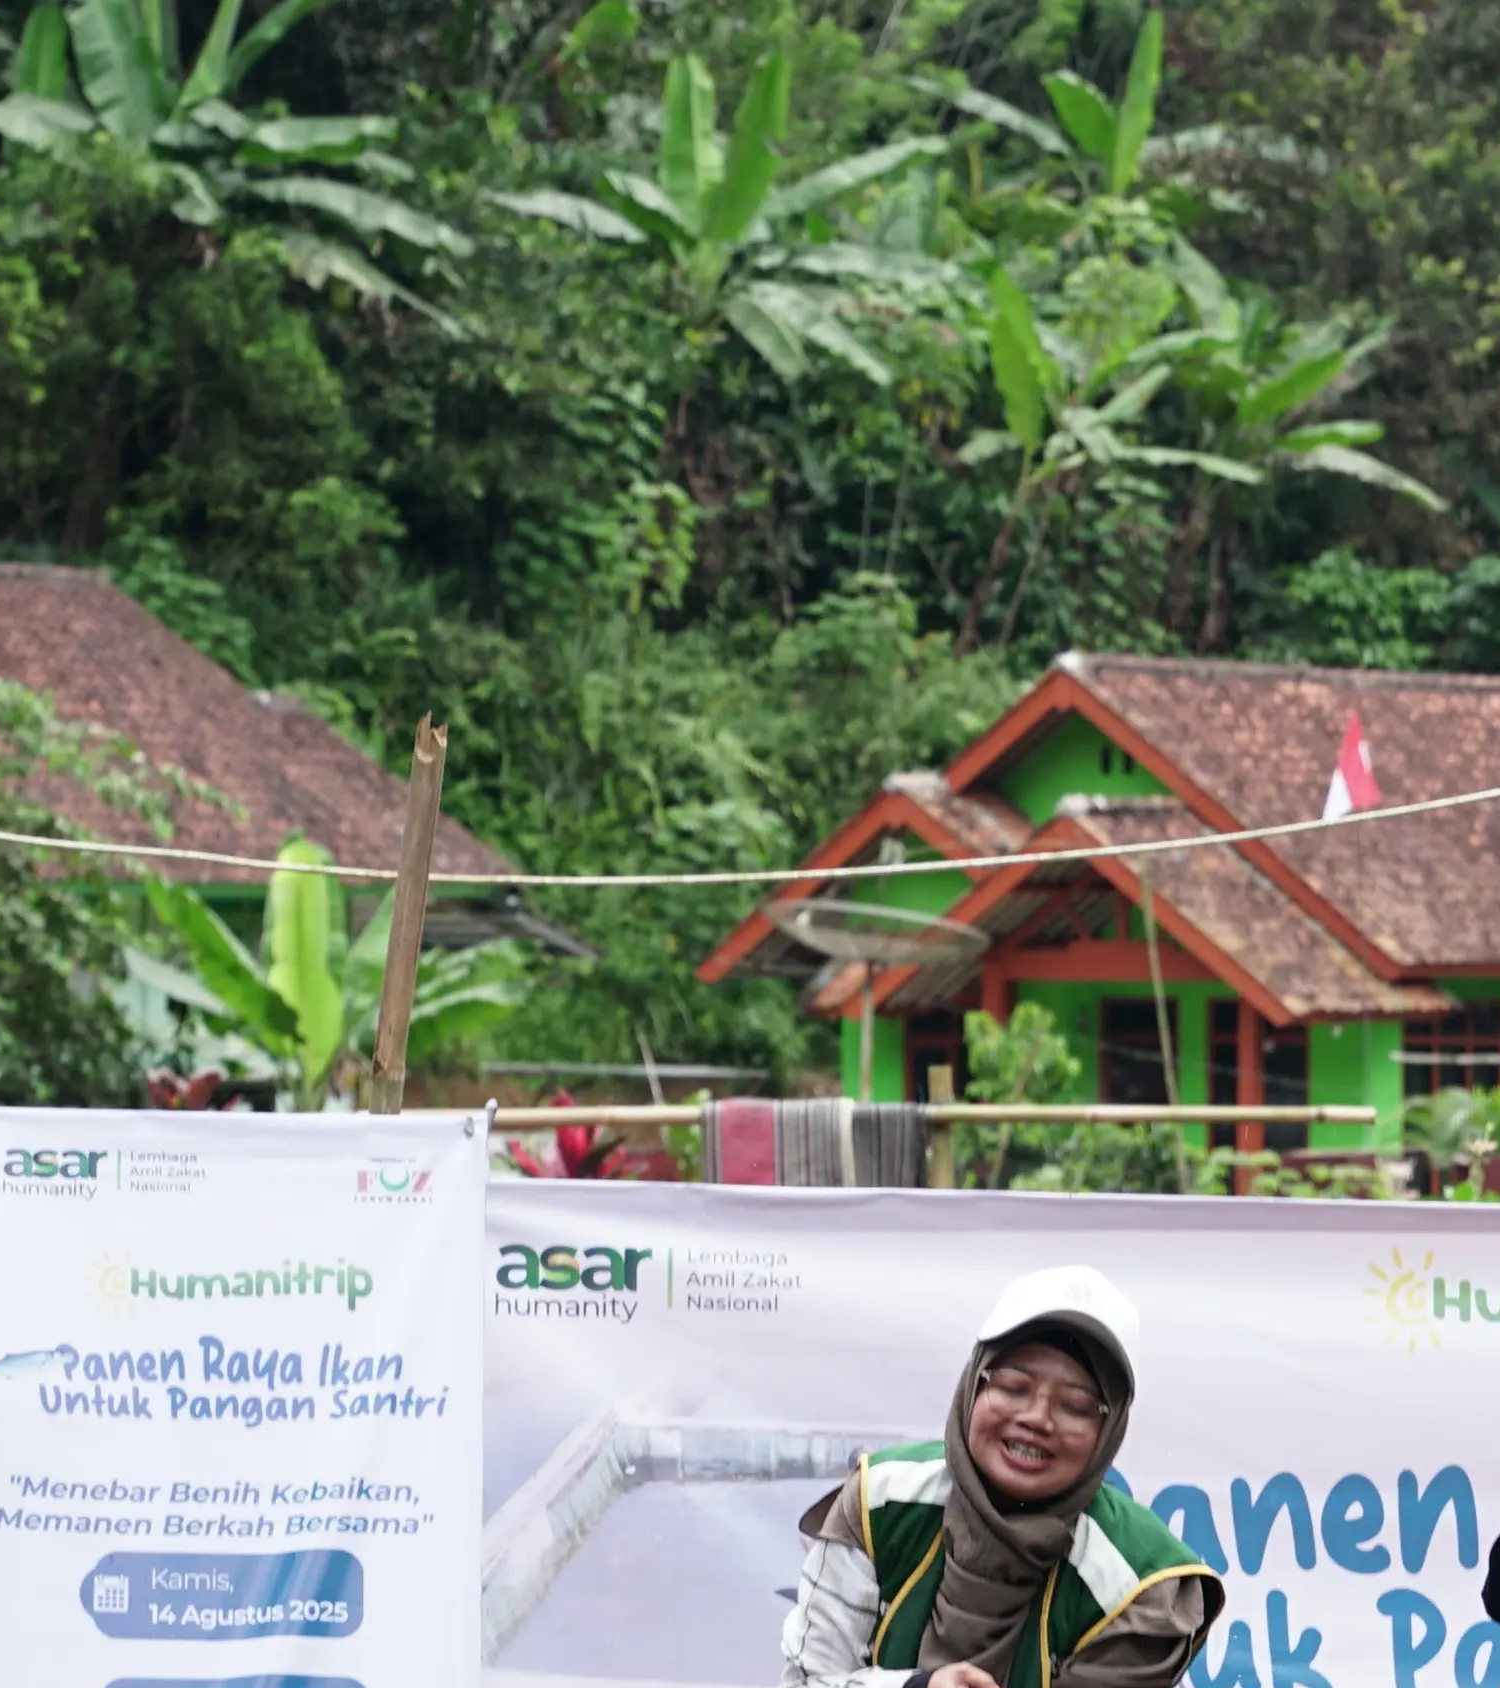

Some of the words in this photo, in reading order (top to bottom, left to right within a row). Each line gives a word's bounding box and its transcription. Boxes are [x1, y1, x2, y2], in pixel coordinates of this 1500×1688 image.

[3, 1148, 108, 1180] asar
[129, 1166, 164, 1177] Amil
[167, 1166, 206, 1179] Zakat
[130, 1150, 198, 1165] Lembaga
[2, 1179, 98, 1201] humanity
[129, 1180, 192, 1193] Nasional
[496, 1243, 653, 1292] asar
[686, 1248, 788, 1268] Lembaga
[130, 1258, 374, 1311] Humanitrip
[686, 1271, 736, 1289] Amil
[742, 1271, 803, 1290] Zakat
[494, 1293, 638, 1325] humanity
[686, 1294, 778, 1313] Nasional
[54, 1343, 186, 1382] Panen
[199, 1335, 303, 1390] Raya
[318, 1343, 404, 1388] Ikan
[39, 1384, 153, 1419] Untuk
[166, 1387, 315, 1427] Pangan
[329, 1386, 450, 1420] Santri
[9, 1474, 162, 1504] "Menebar
[169, 1481, 261, 1505] Benih
[271, 1477, 421, 1508] Kebaikan,
[162, 1514, 275, 1538] Berkah
[285, 1512, 435, 1537] Bersama"
[1104, 1465, 1480, 1577] anen
[151, 1567, 236, 1595] Kamis,
[148, 1603, 177, 1625] 14
[181, 1602, 284, 1631] Agustus
[289, 1599, 349, 1624] 2025
